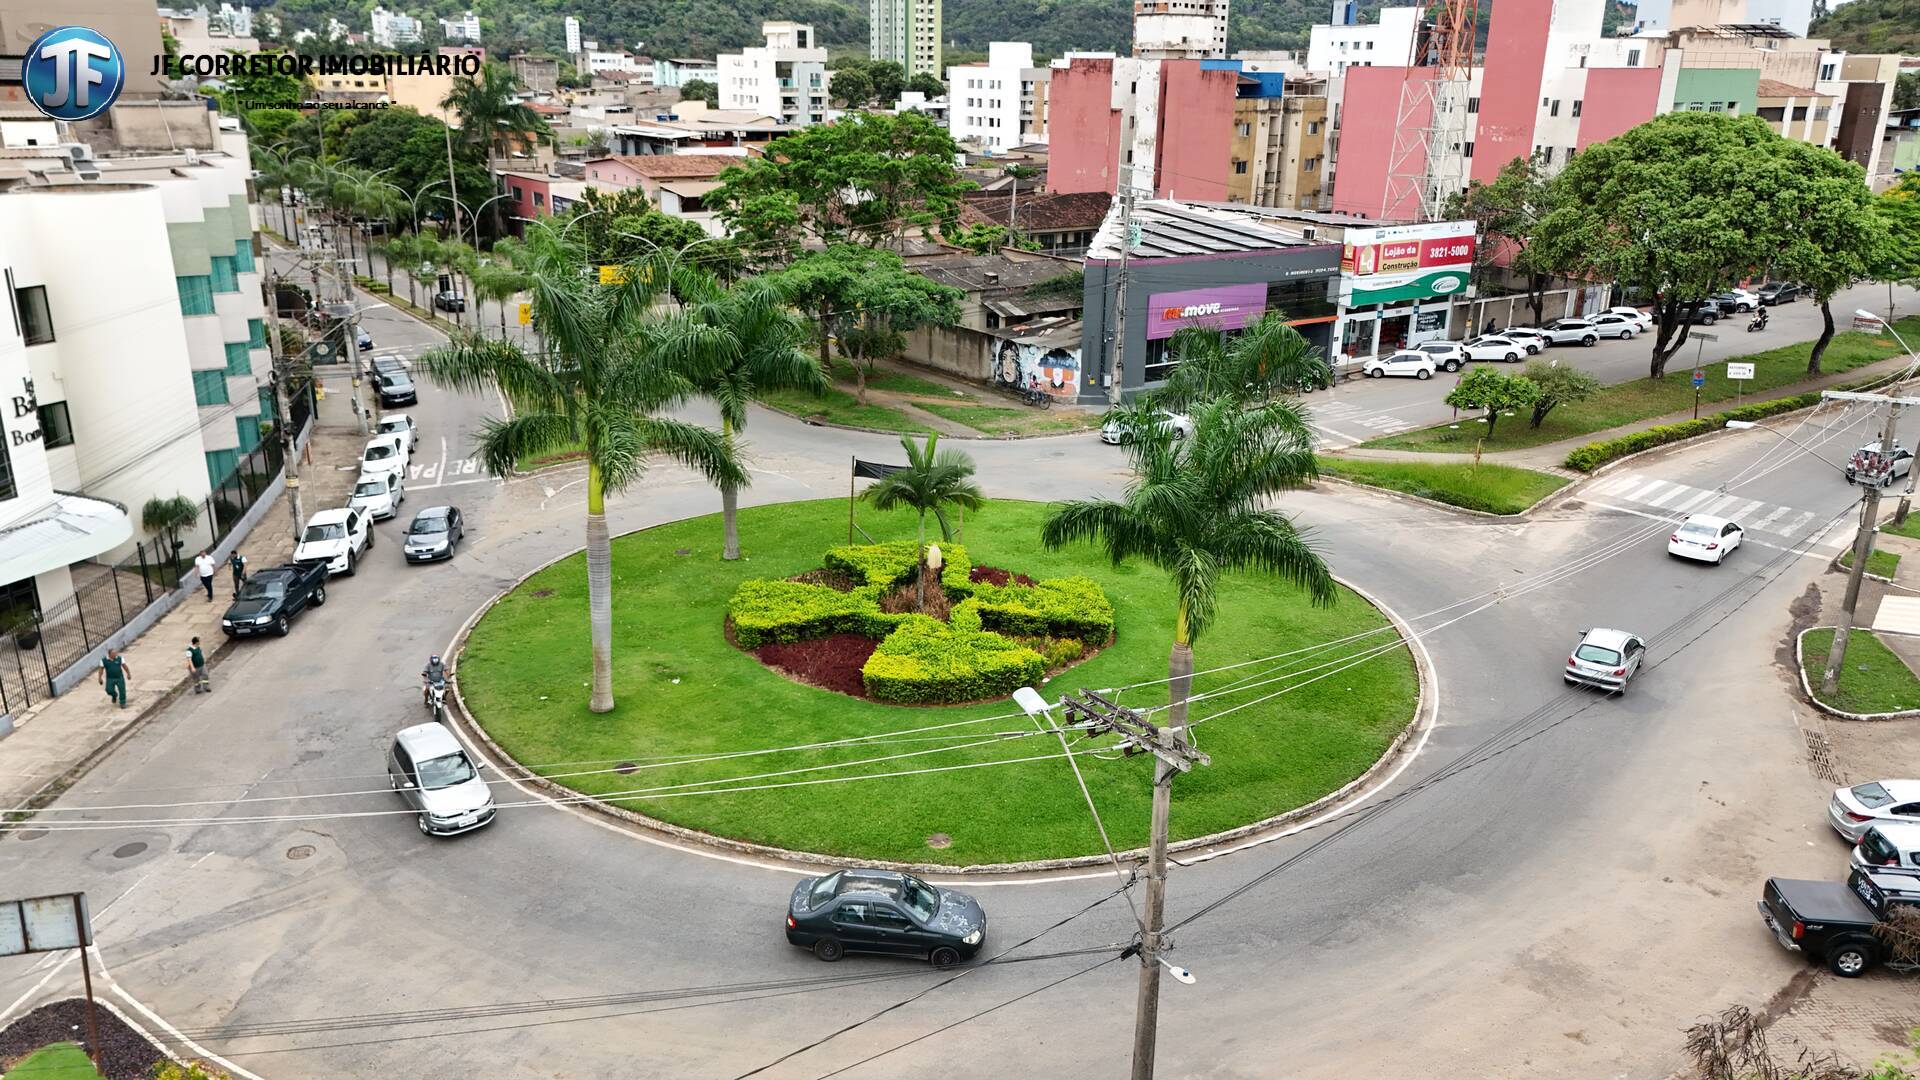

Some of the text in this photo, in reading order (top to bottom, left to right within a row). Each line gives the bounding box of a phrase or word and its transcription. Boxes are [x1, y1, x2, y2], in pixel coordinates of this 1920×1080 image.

[1384, 245, 1417, 257] Lojão da
[1429, 245, 1469, 258] 3821-5000
[1382, 261, 1418, 271] Construção
